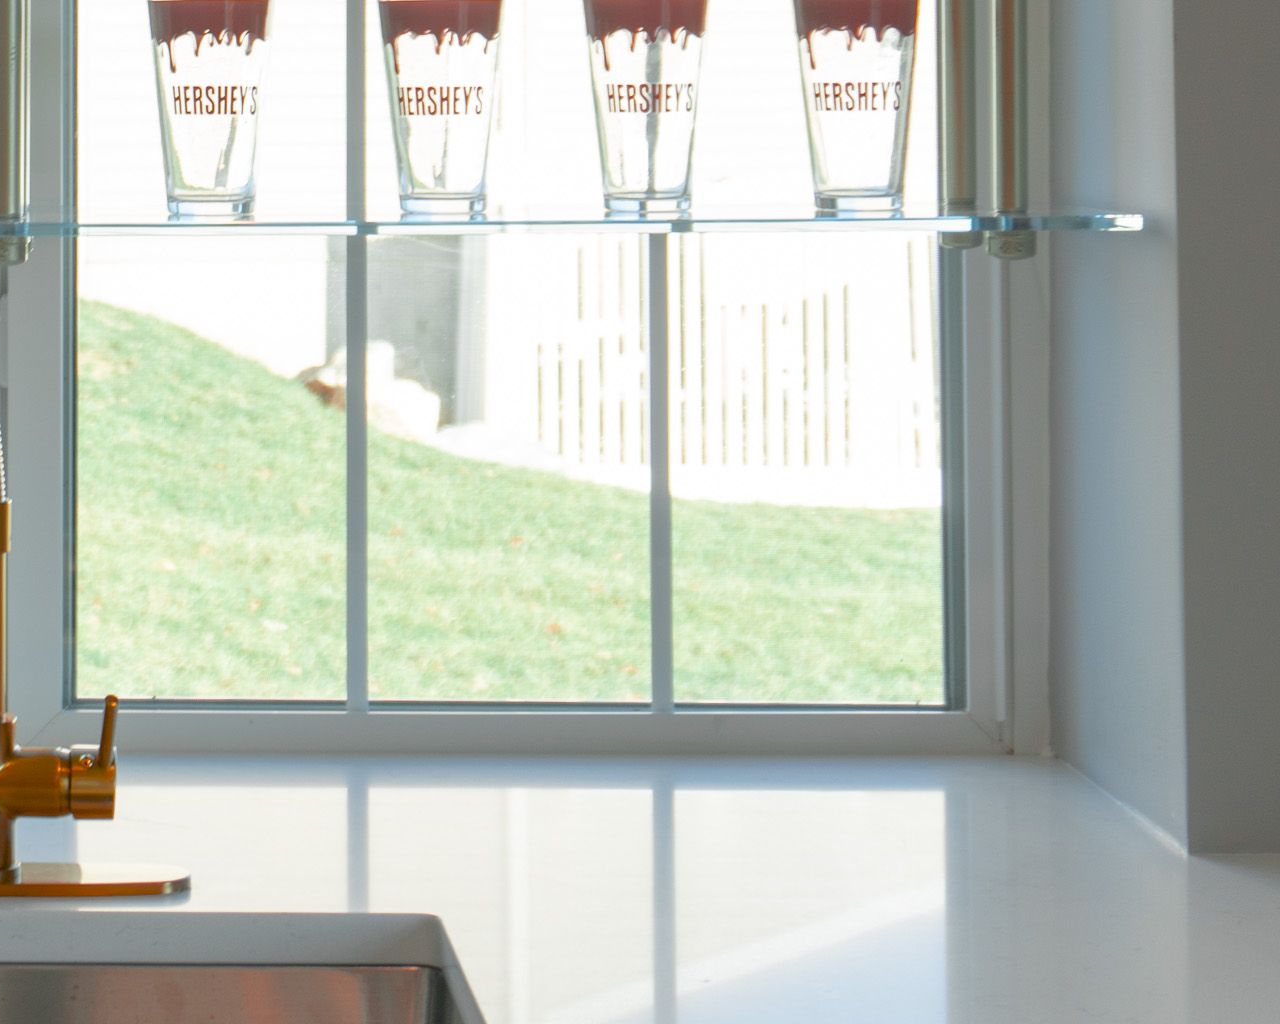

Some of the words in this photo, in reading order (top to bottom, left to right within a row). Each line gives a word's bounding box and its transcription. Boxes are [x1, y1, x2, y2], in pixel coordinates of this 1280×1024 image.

[172, 85, 258, 115] HERSHEY'S
[397, 86, 483, 116] HERSHEY'S
[607, 83, 694, 113] HERSHEY'S
[812, 82, 901, 111] HERSHEY'S
